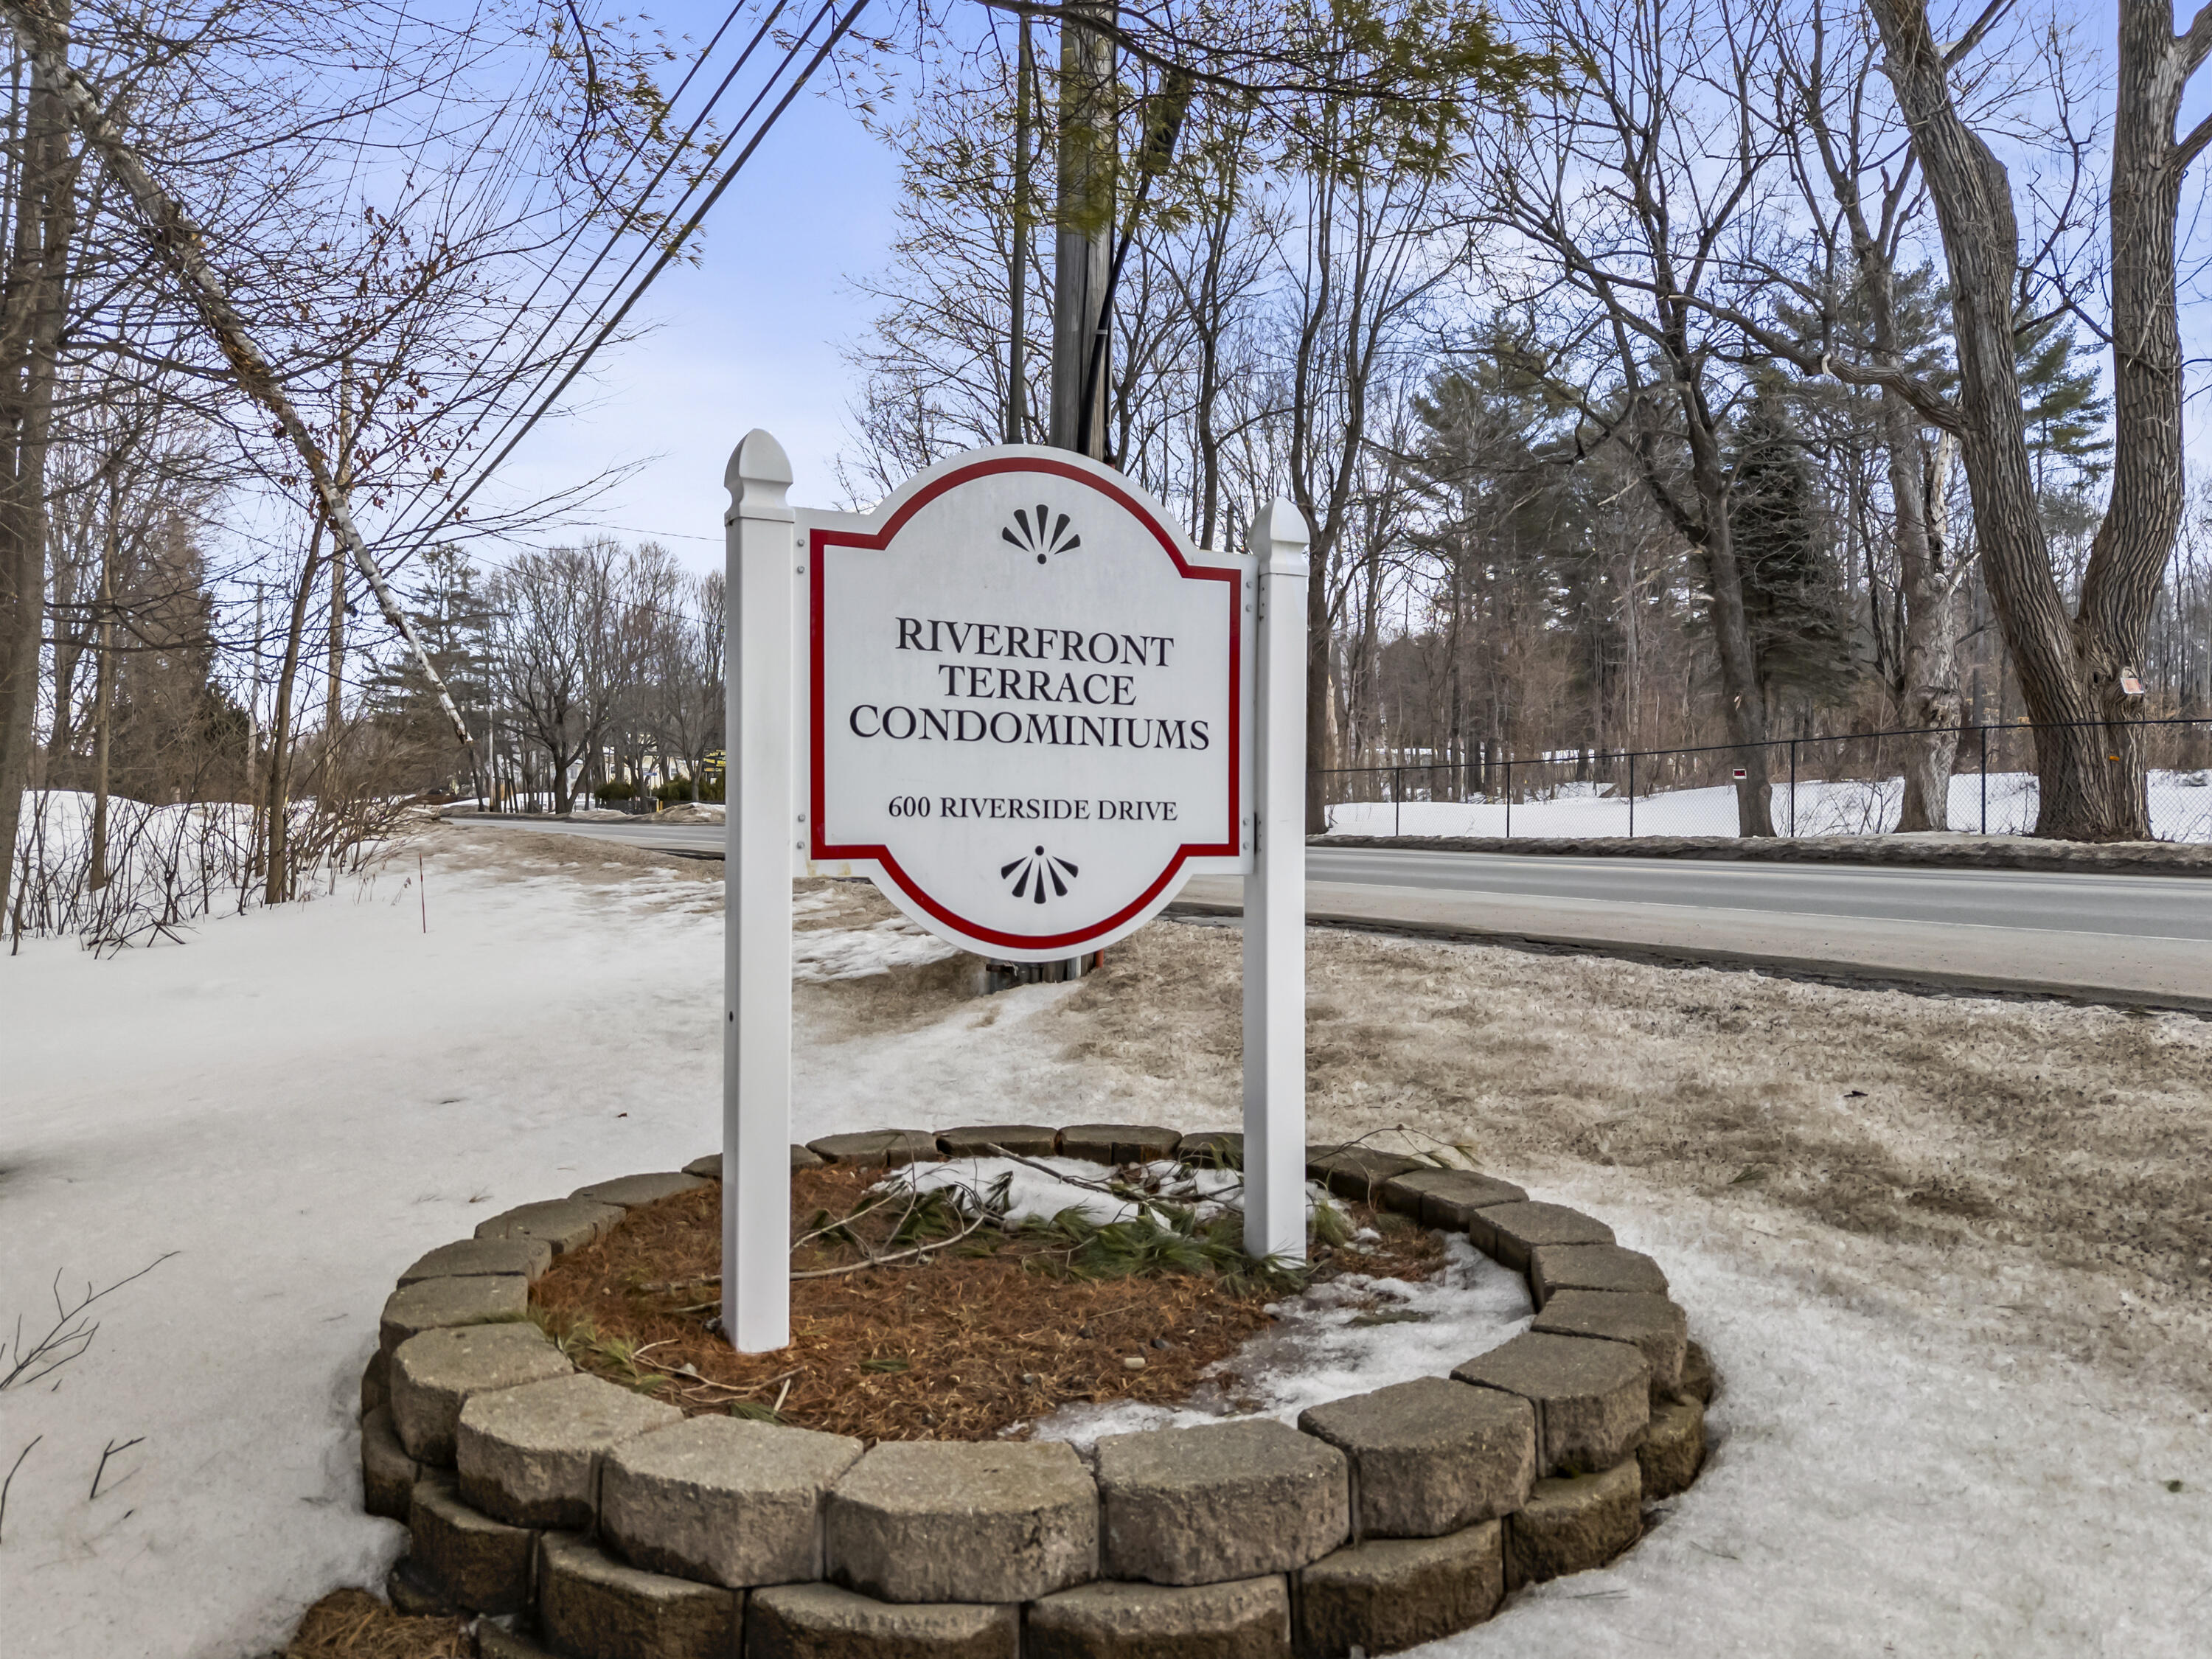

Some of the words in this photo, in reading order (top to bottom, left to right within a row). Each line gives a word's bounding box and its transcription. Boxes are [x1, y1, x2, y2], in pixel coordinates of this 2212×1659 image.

[895, 617, 1175, 667] RIVERFRONT
[938, 664, 1137, 706] TERRACE
[849, 704, 1210, 751] CONDOMINIUMS
[888, 796, 931, 818] 600
[940, 797, 1090, 820] RIVERSIDE
[1098, 800, 1178, 821] DRIVE
